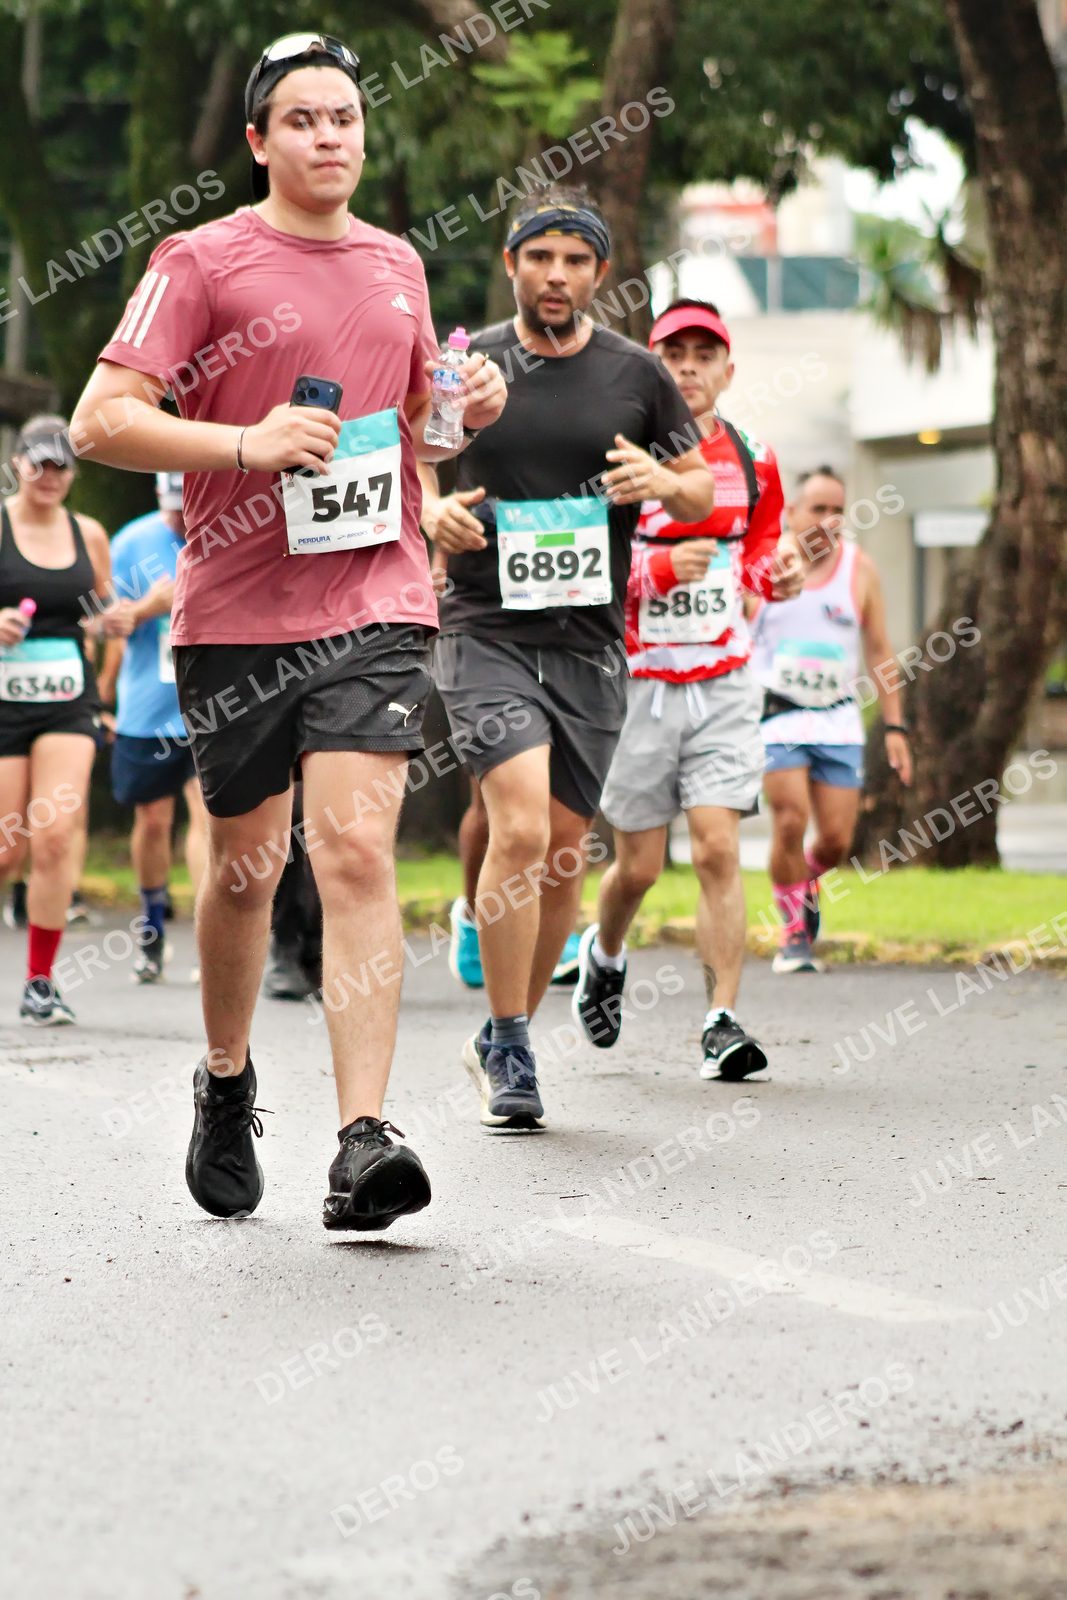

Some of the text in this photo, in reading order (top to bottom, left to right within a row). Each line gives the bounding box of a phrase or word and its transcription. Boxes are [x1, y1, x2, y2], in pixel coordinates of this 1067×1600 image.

[311, 472, 393, 524] 547
[297, 535, 331, 545] PERDURA
[506, 547, 603, 584] 6892
[6, 675, 76, 698] 6340
